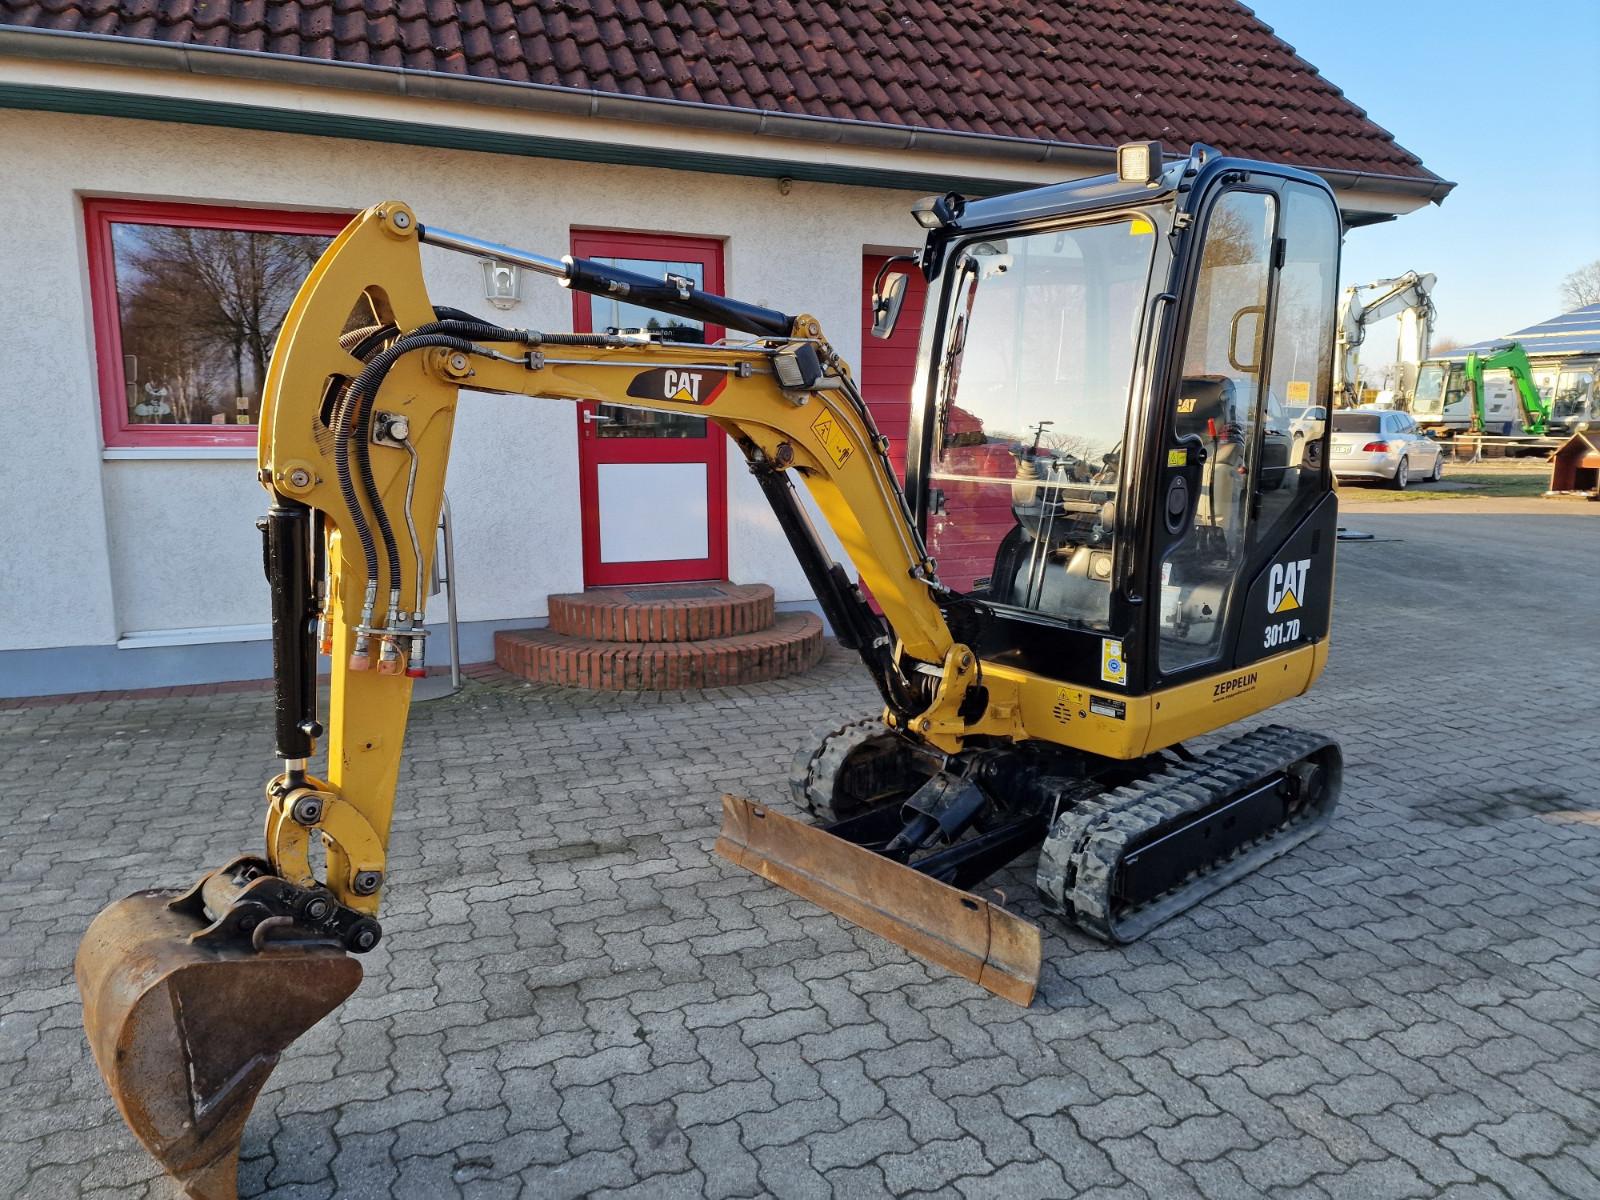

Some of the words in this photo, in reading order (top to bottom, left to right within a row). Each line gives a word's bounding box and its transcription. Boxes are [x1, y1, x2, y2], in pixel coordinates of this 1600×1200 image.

[664, 369, 703, 402] CAT
[1267, 559, 1312, 614] CAT
[1263, 618, 1301, 649] 301.7D
[1213, 671, 1258, 697] ZEPPELIN
